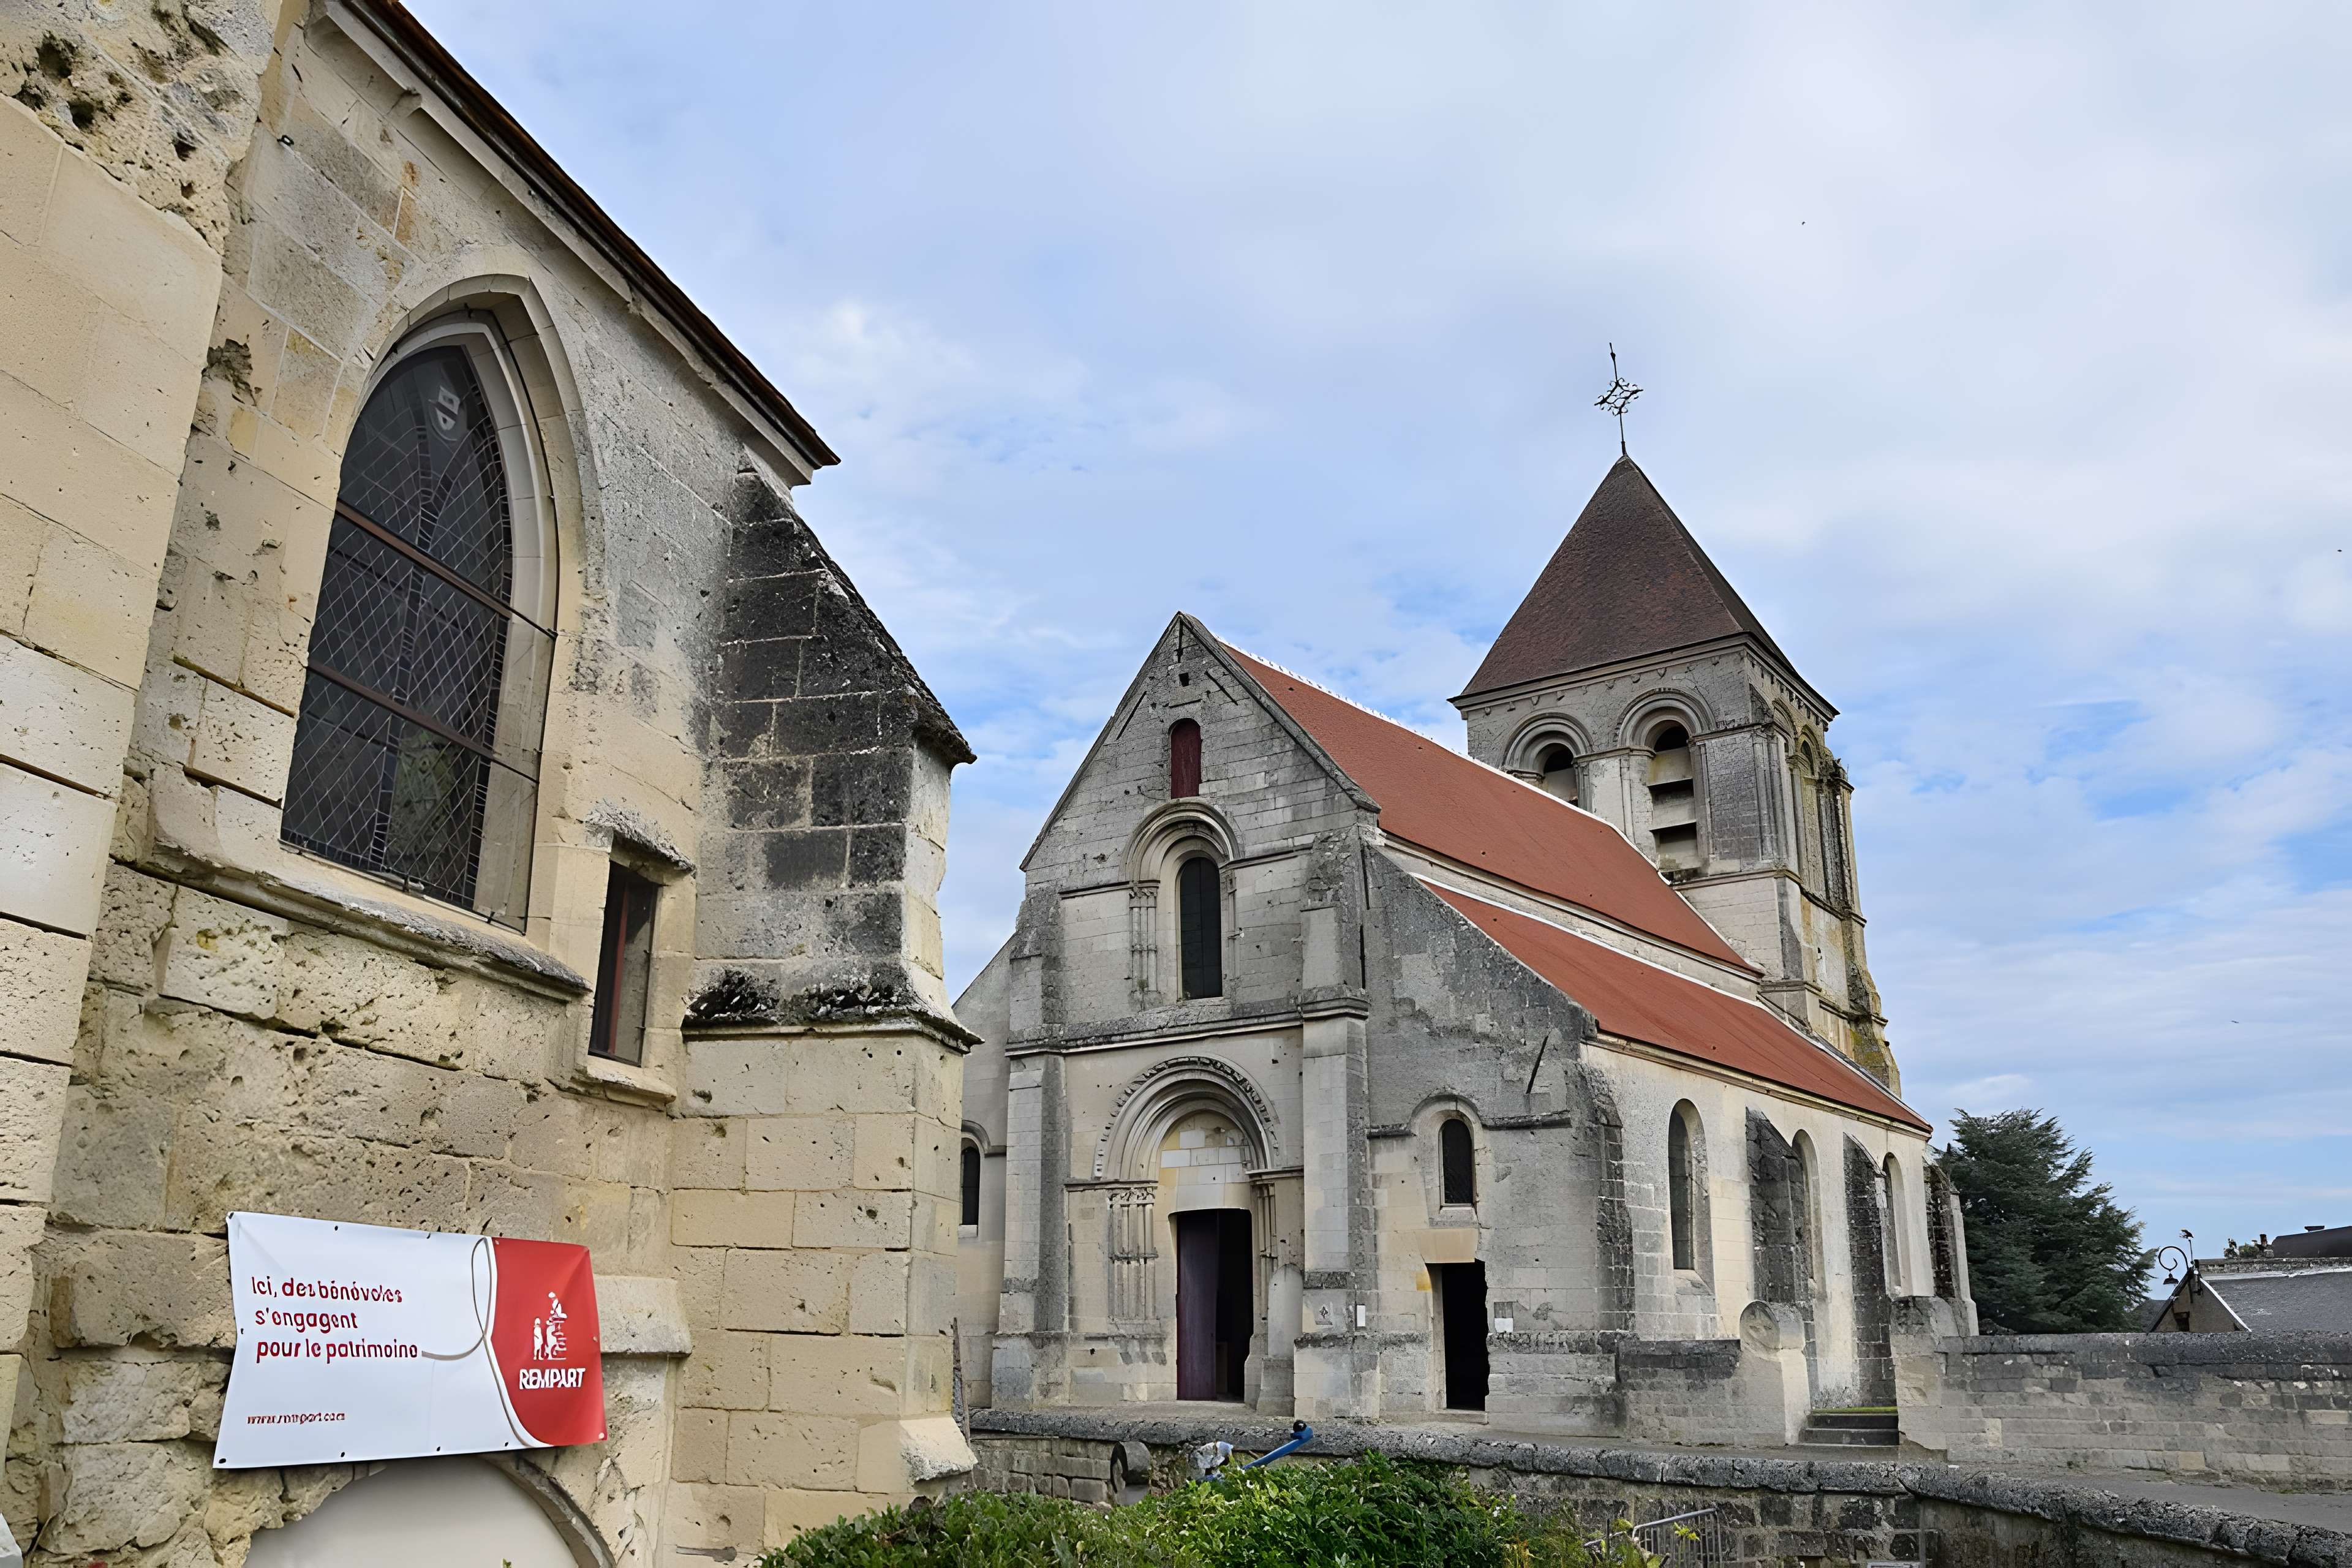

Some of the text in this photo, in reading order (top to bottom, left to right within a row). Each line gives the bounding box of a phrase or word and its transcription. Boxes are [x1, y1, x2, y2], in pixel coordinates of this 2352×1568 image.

[251, 1275, 277, 1298] Ici,
[282, 1277, 316, 1298] des
[256, 1338, 418, 1364] pour le patrimoine
[519, 1367, 586, 1390] REMPART
